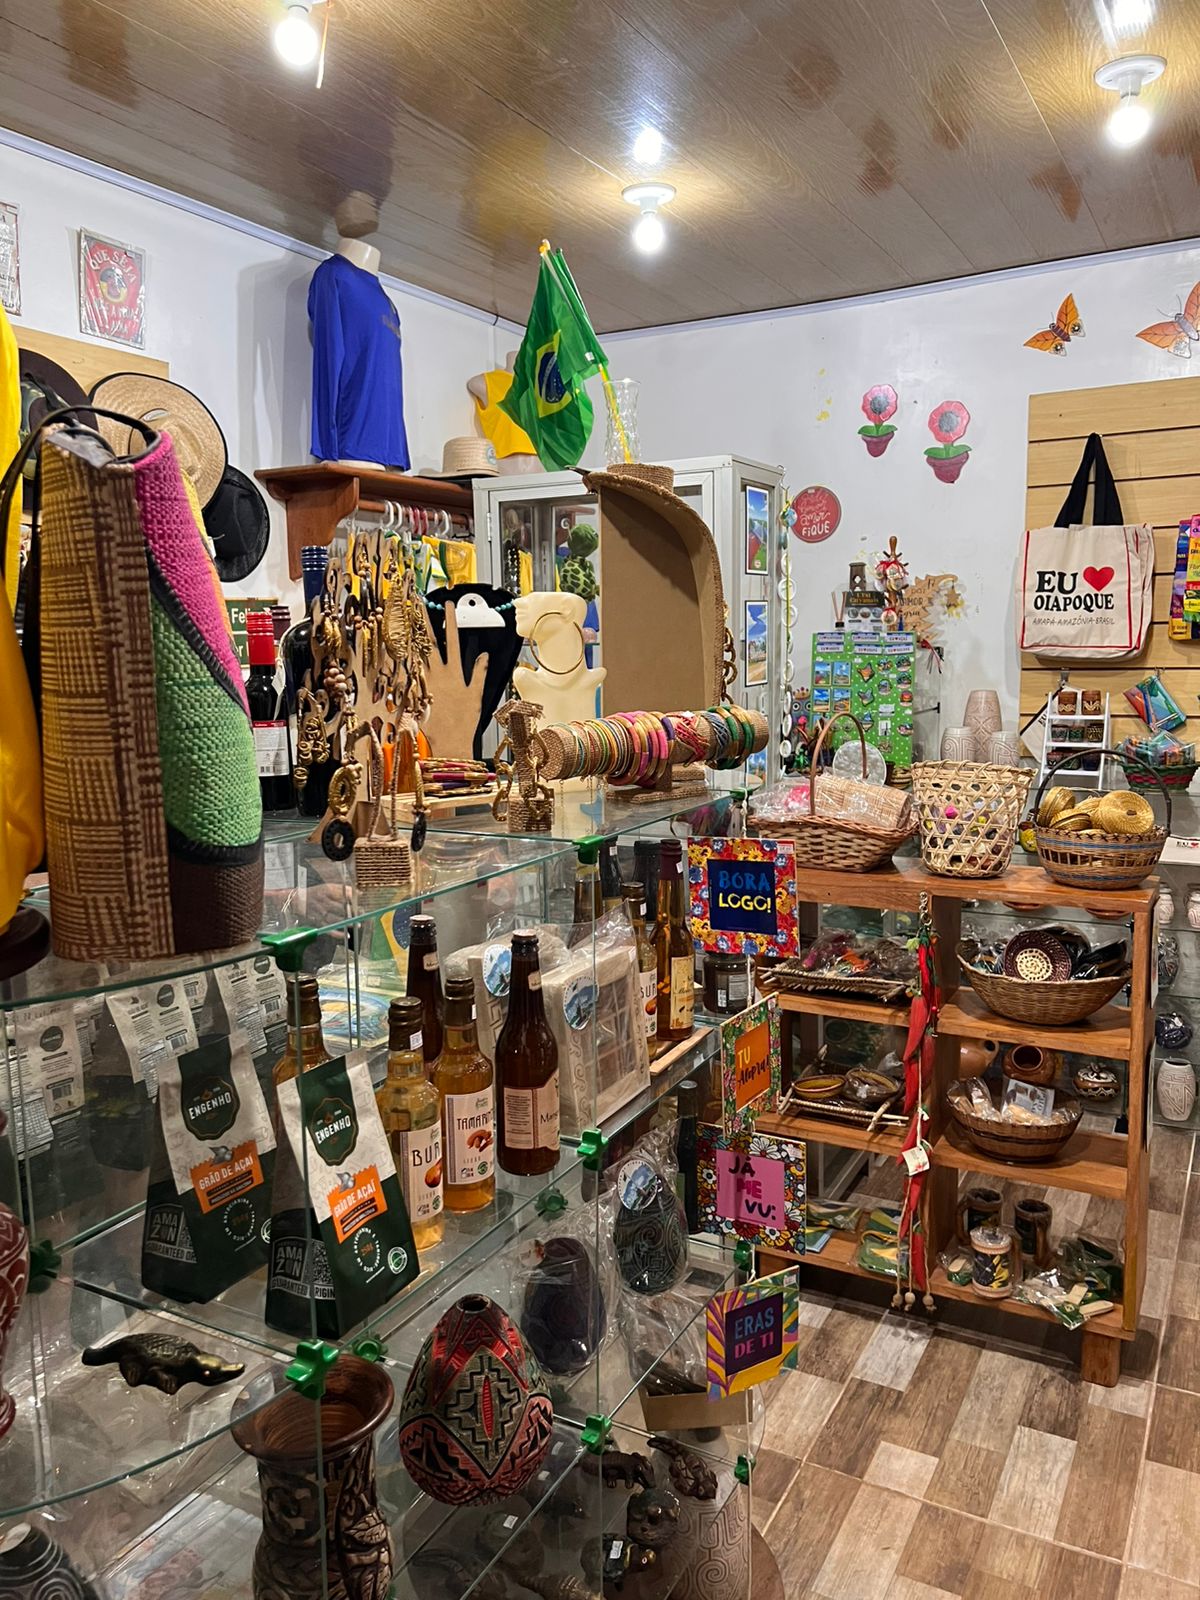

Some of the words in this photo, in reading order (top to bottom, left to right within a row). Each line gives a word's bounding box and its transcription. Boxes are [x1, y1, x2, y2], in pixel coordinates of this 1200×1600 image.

[90, 249, 109, 271] QUE
[1035, 570, 1078, 595] EU
[1034, 593, 1114, 613] OIAPOQUE
[719, 870, 771, 892] BORA
[718, 892, 771, 913] LOGO!
[737, 1046, 751, 1069] TU
[188, 1091, 232, 1121] ENGENHO
[315, 1114, 351, 1145] ENGENHO
[199, 1171, 220, 1190] GRÃO
[221, 1164, 234, 1179] DE
[234, 1152, 254, 1172] AÇAÍ
[728, 1155, 755, 1178] JÁ
[347, 1191, 357, 1206] DE
[357, 1181, 376, 1200] AÇAÍ
[737, 1178, 762, 1200] ME
[152, 1213, 178, 1227] AMA
[276, 1246, 303, 1261] AMA
[313, 1286, 335, 1298] RIGIN
[735, 1306, 774, 1340] ERAS
[734, 1339, 755, 1360] DE
[761, 1331, 774, 1348] TI
